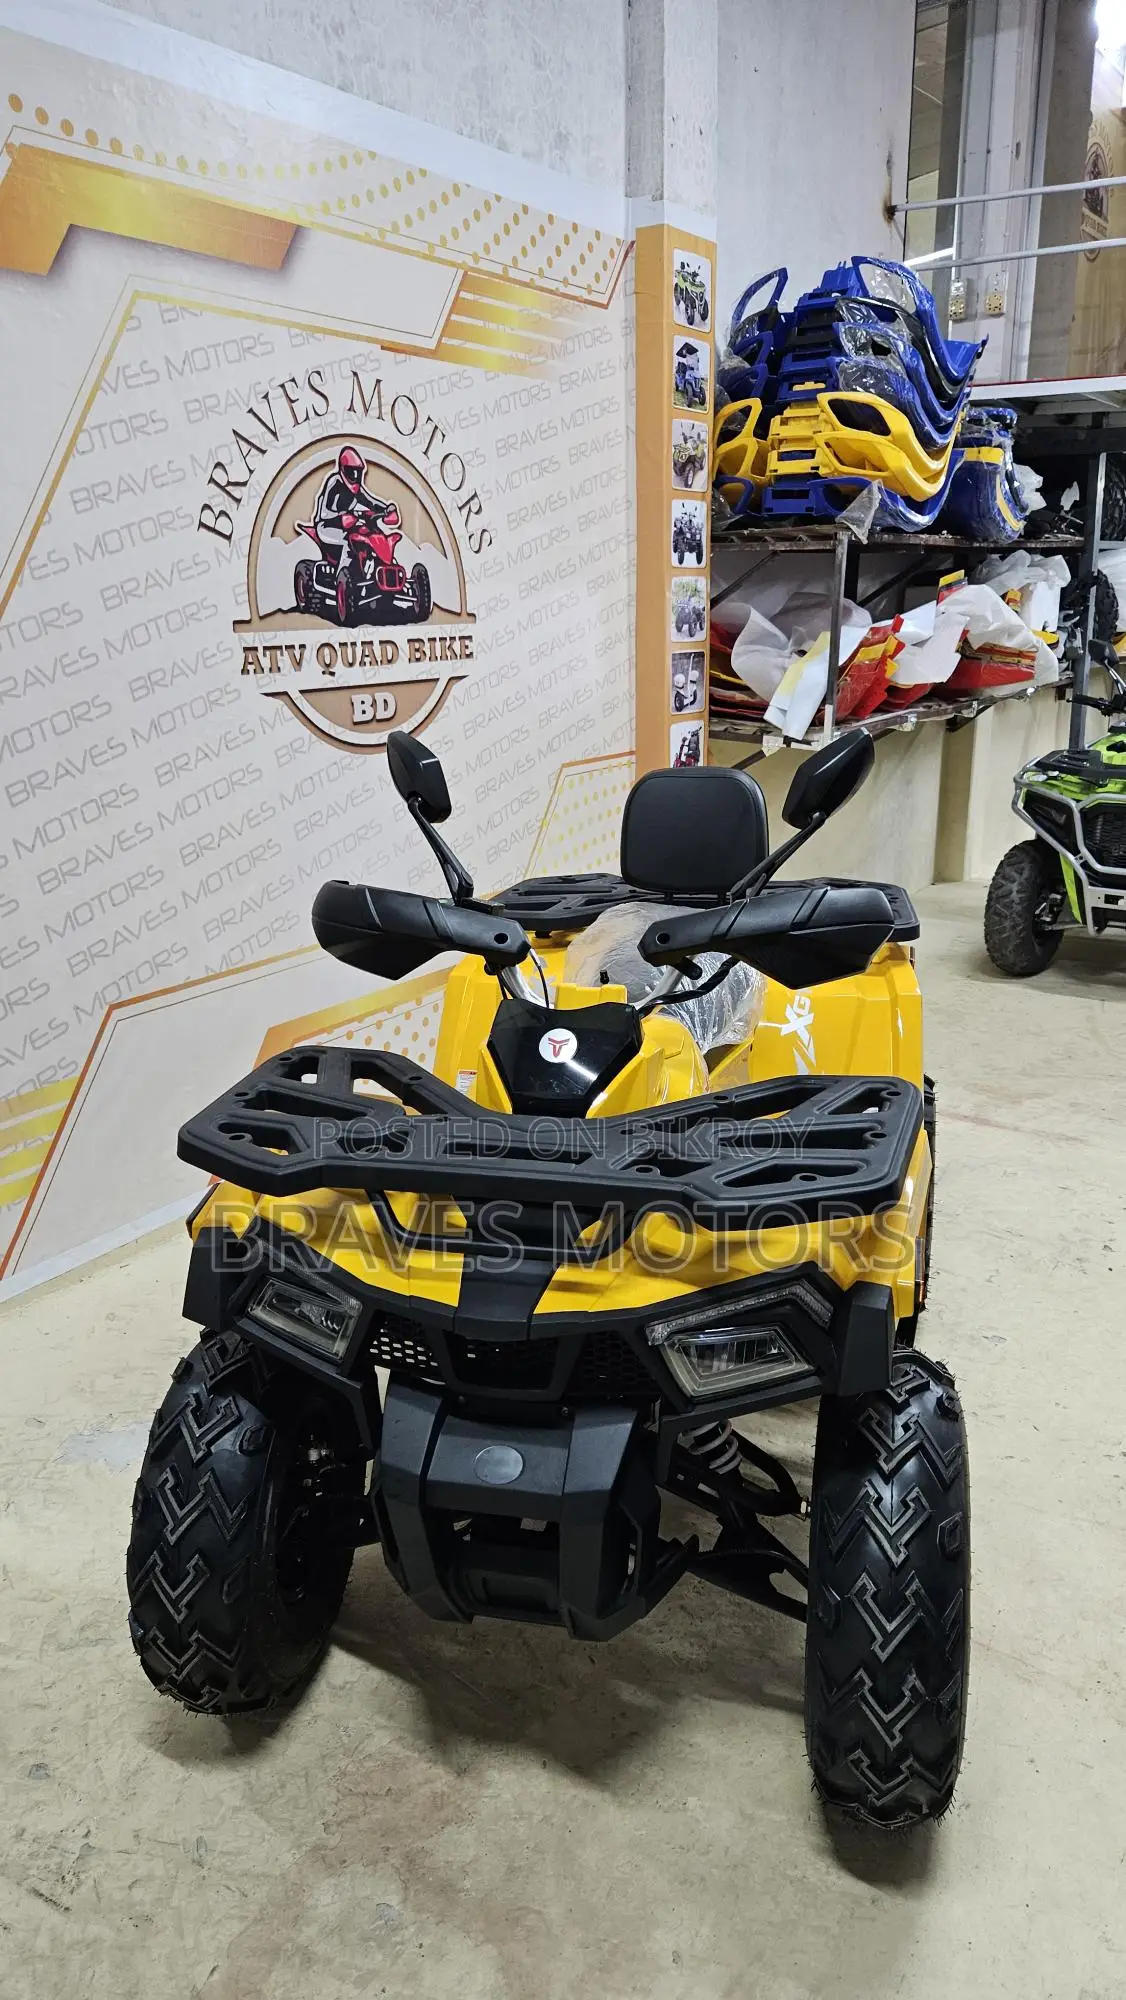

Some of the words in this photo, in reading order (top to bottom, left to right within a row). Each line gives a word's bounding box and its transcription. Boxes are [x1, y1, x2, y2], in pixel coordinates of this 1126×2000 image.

[164, 332, 275, 380] MOTORS
[483, 382, 551, 424] MOTORS
[559, 359, 617, 395] BRAVES
[71, 409, 169, 459] OTORS
[495, 420, 559, 459] BRAVES
[561, 395, 620, 432] MOTORS
[70, 460, 186, 514] BRAVES
[198, 370, 330, 547] BRAVES
[348, 370, 492, 555] MOTORS
[496, 456, 561, 496] MOTORS
[568, 429, 623, 465] BRAVES
[507, 490, 568, 531] BRAVES
[570, 463, 627, 502] MOTORS
[73, 506, 195, 565] MOTORS
[507, 523, 570, 568] MOTORS
[100, 553, 211, 611] BRAVES
[516, 590, 580, 633] MOTORS
[518, 558, 577, 601] BRAVES
[0, 645, 100, 704] RAVES
[103, 597, 218, 660] MOTORS
[129, 640, 234, 702] BRAVES
[241, 643, 306, 675] ATV
[315, 640, 399, 677] QUAD
[406, 635, 474, 664] BIKE
[452, 660, 521, 711] MOTORS
[529, 622, 586, 667] BRAVES
[350, 691, 397, 725] BD
[462, 690, 527, 740] BRAVES
[528, 662, 588, 703] MOTORS
[465, 725, 530, 774] MOTORS
[538, 686, 593, 729] BRAVES
[5, 736, 128, 808] BRAVES
[131, 682, 241, 748] MOTORS
[475, 752, 537, 804] BRAVES
[538, 713, 596, 759] MOTORS
[12, 783, 139, 860] MOTORS
[155, 722, 256, 788] BRAVES
[476, 785, 540, 838] MOTORS
[37, 821, 154, 895] BRAVES
[157, 762, 263, 832] MOTORS
[44, 864, 164, 944] MOTORS
[180, 800, 276, 868] BRAVES
[67, 900, 178, 978] BRAVES
[181, 838, 282, 909] MOTORS
[294, 782, 376, 842] BRAVES
[73, 942, 188, 1024] MOTORS
[202, 873, 295, 943] BRAVES
[297, 820, 383, 885] MOTORS
